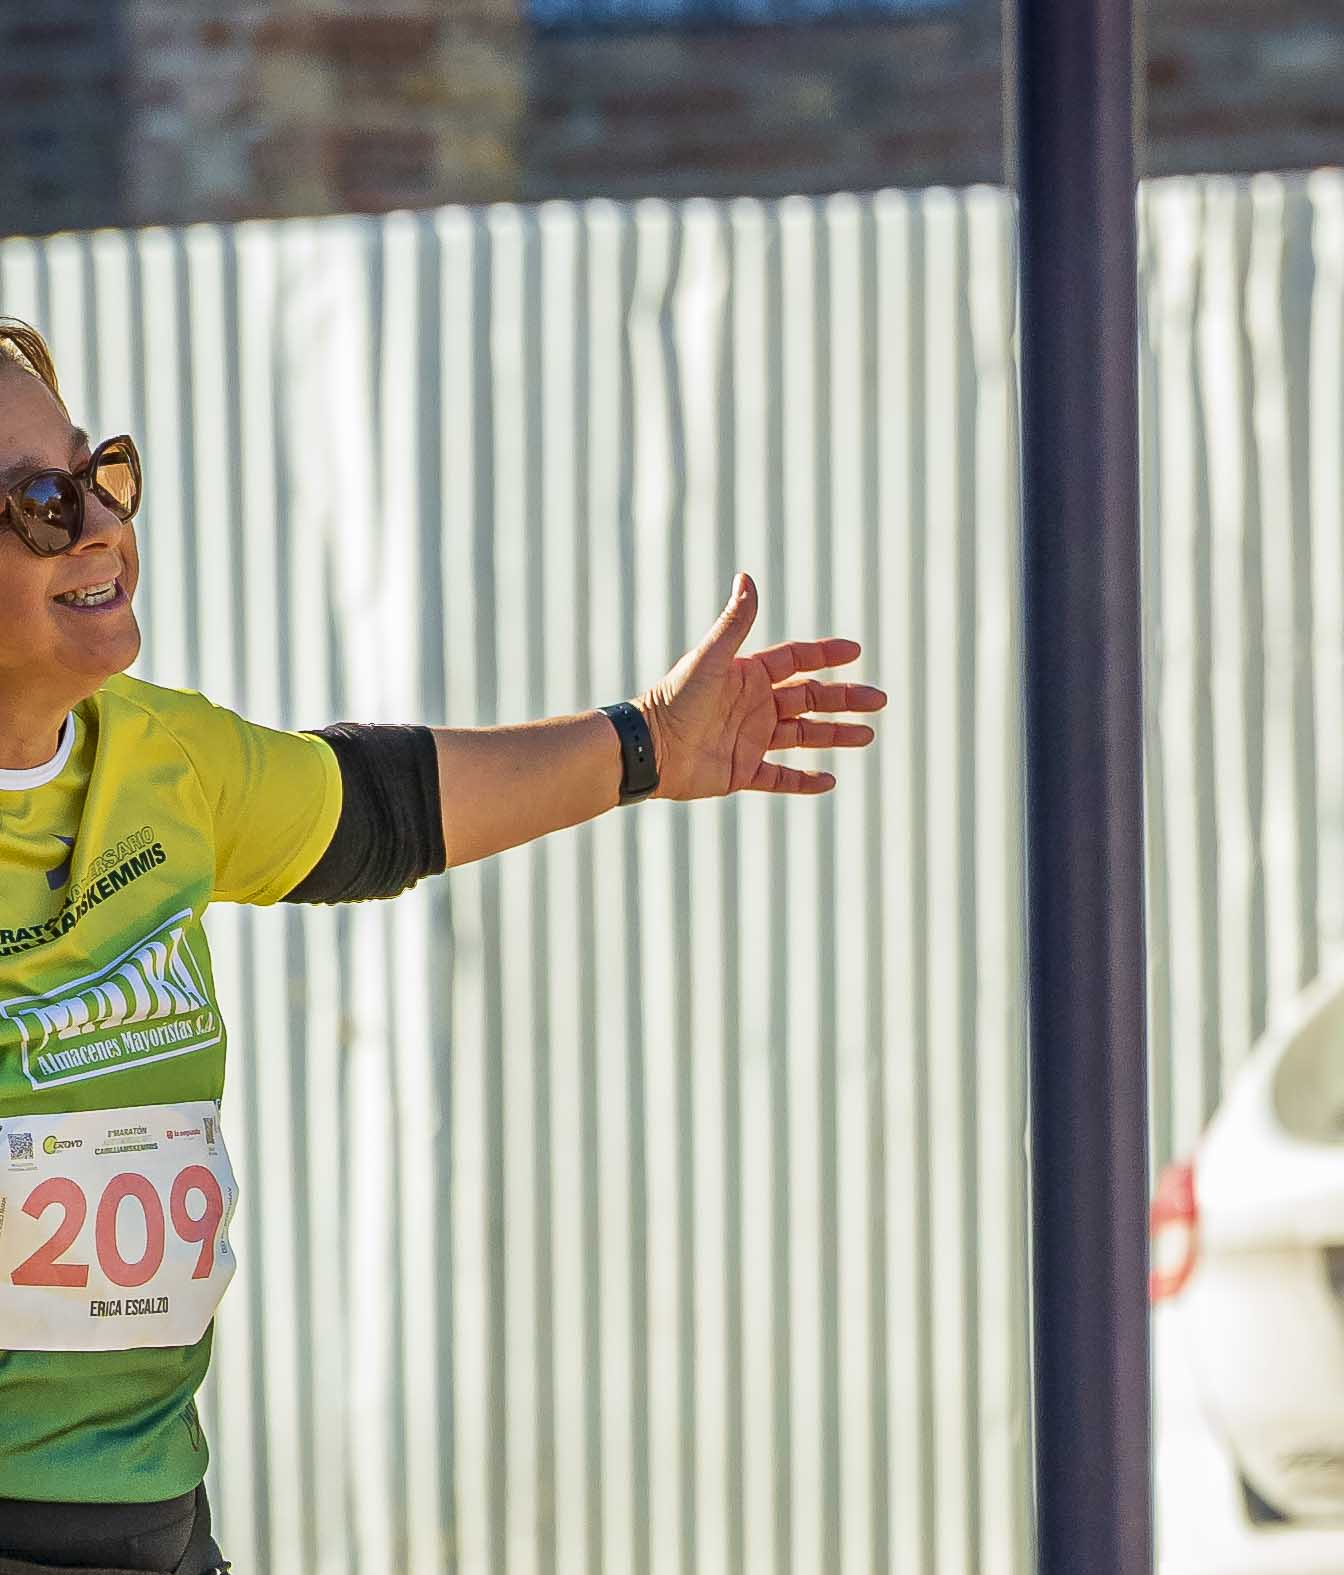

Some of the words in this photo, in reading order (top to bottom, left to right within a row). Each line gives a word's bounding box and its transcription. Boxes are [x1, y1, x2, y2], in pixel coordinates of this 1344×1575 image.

[37, 1037, 122, 1076] Almacenes
[120, 1016, 193, 1054] Mayoristas
[10, 1165, 225, 1288] 209
[90, 1300, 122, 1317] ERICA
[124, 1296, 169, 1316] ESCALZO
